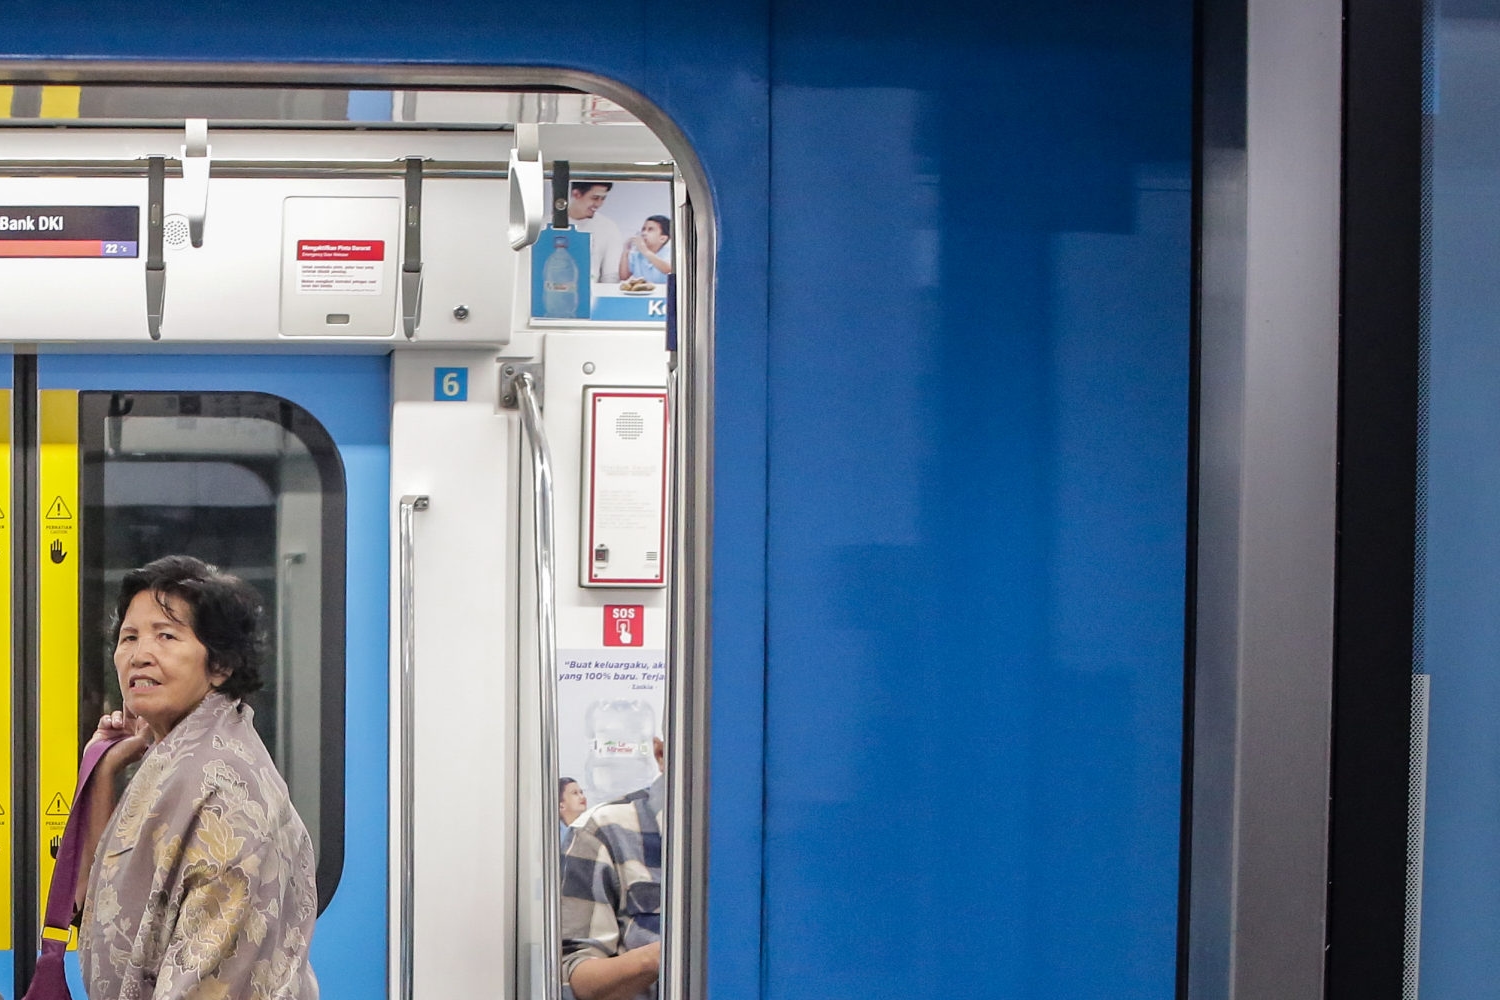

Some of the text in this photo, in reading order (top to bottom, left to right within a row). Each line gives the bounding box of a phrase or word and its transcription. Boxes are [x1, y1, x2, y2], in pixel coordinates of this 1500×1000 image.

[0, 215, 35, 231] Bank
[38, 215, 64, 231] DKI
[105, 243, 118, 254] 22
[442, 372, 460, 396] 6
[612, 608, 635, 619] SOS
[559, 673, 583, 681] yang
[585, 672, 611, 680] 100%
